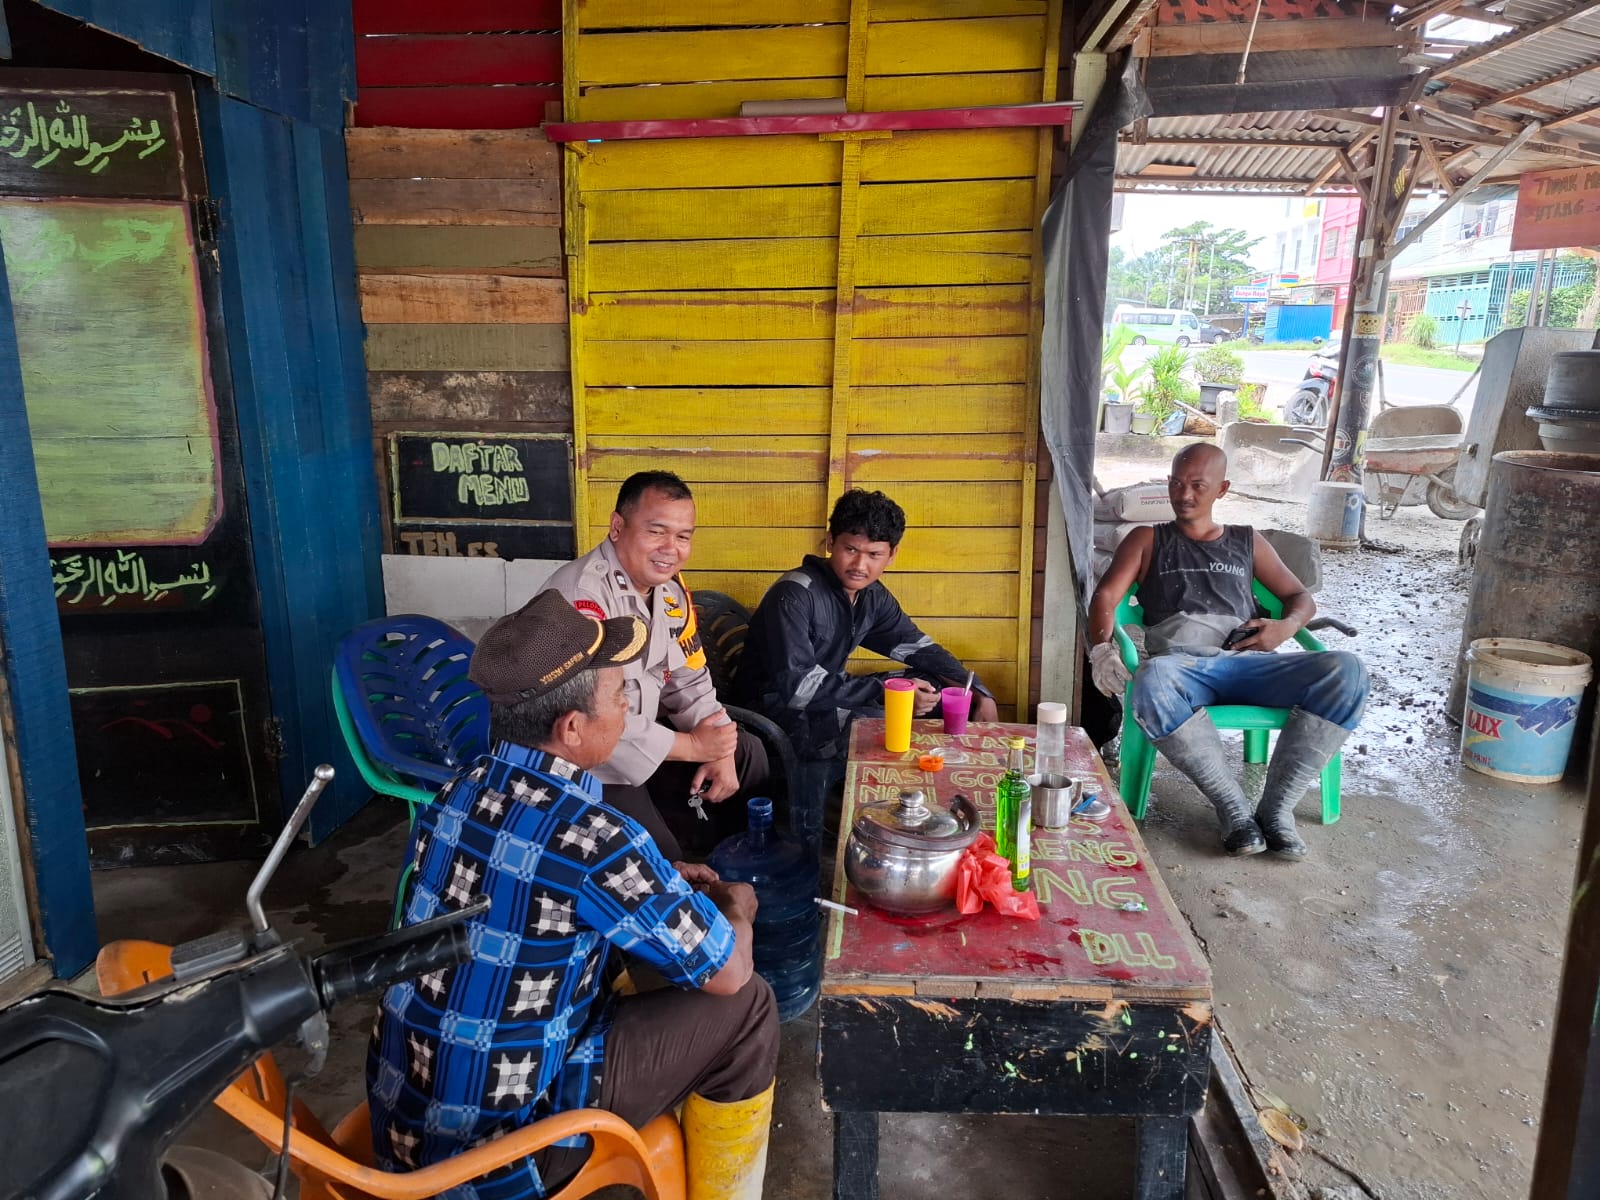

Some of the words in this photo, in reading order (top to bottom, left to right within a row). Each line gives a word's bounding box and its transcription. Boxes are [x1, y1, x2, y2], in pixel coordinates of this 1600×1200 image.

[432, 442, 524, 473] DAFTAR
[458, 474, 529, 505] MENU
[1210, 562, 1245, 576] YOUNG
[861, 766, 936, 785] NASI
[1079, 928, 1176, 969] DLL
